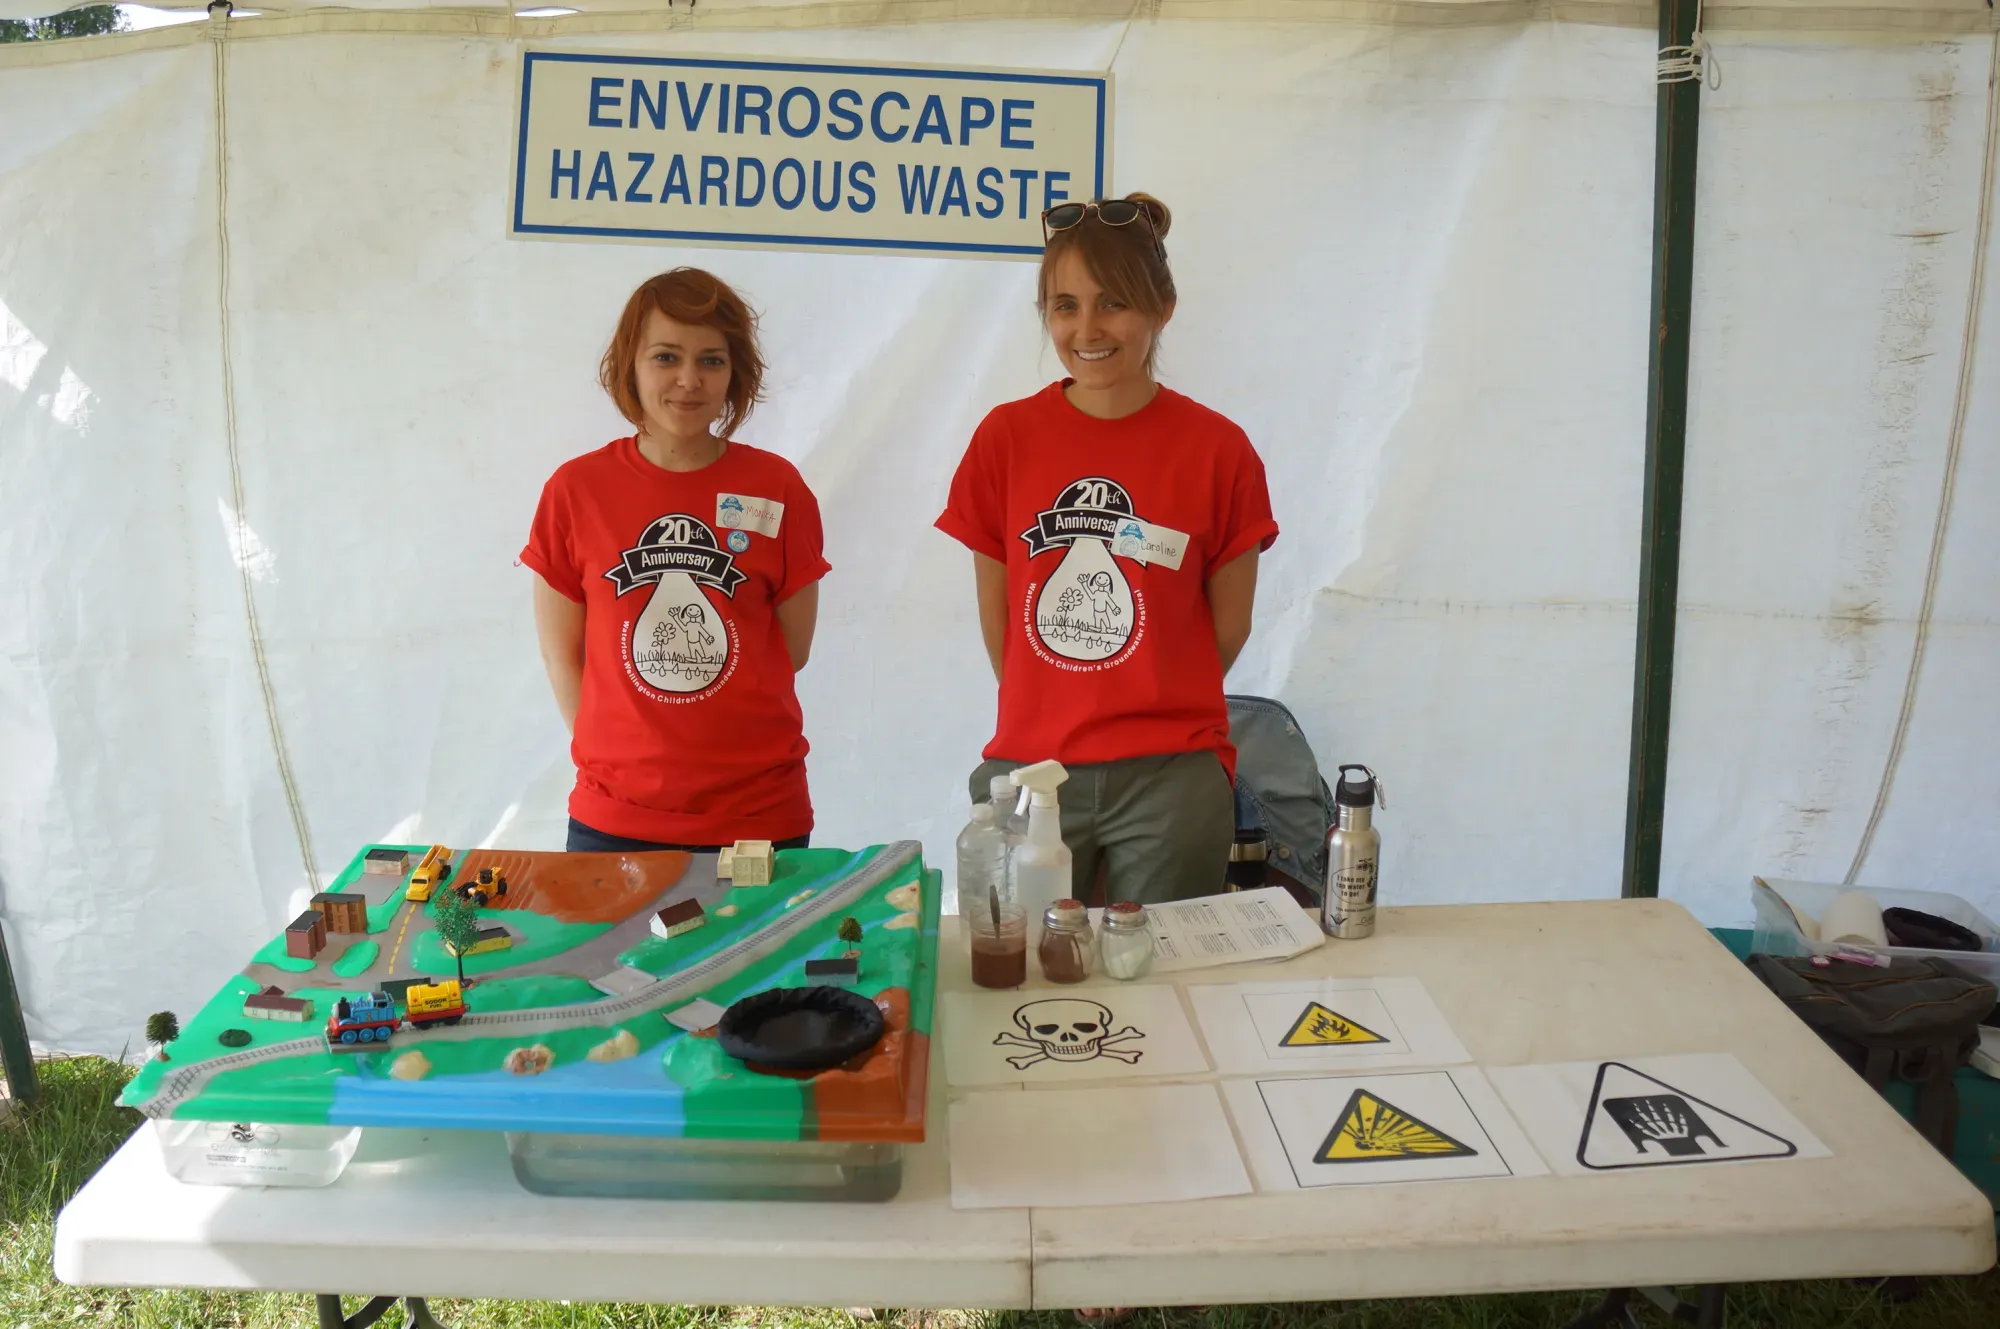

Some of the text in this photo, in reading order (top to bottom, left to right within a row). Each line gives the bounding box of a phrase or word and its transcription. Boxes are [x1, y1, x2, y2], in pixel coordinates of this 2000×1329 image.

[588, 76, 1035, 150] ENVIROSCAPE
[550, 148, 1071, 220] HAZARDOUS WASTE
[1073, 481, 1121, 509] 20th
[657, 519, 705, 544] 20th
[1055, 512, 1116, 533] Anniversa
[641, 548, 715, 572] Anniversary
[1141, 539, 1177, 557] Caroline
[1024, 582, 1146, 672] Waterloo Wellington Children's Groundwater Festival
[620, 619, 740, 704] Waterloo Wellington Children's Groundwater Festival
[424, 997, 447, 1006] SODOR
